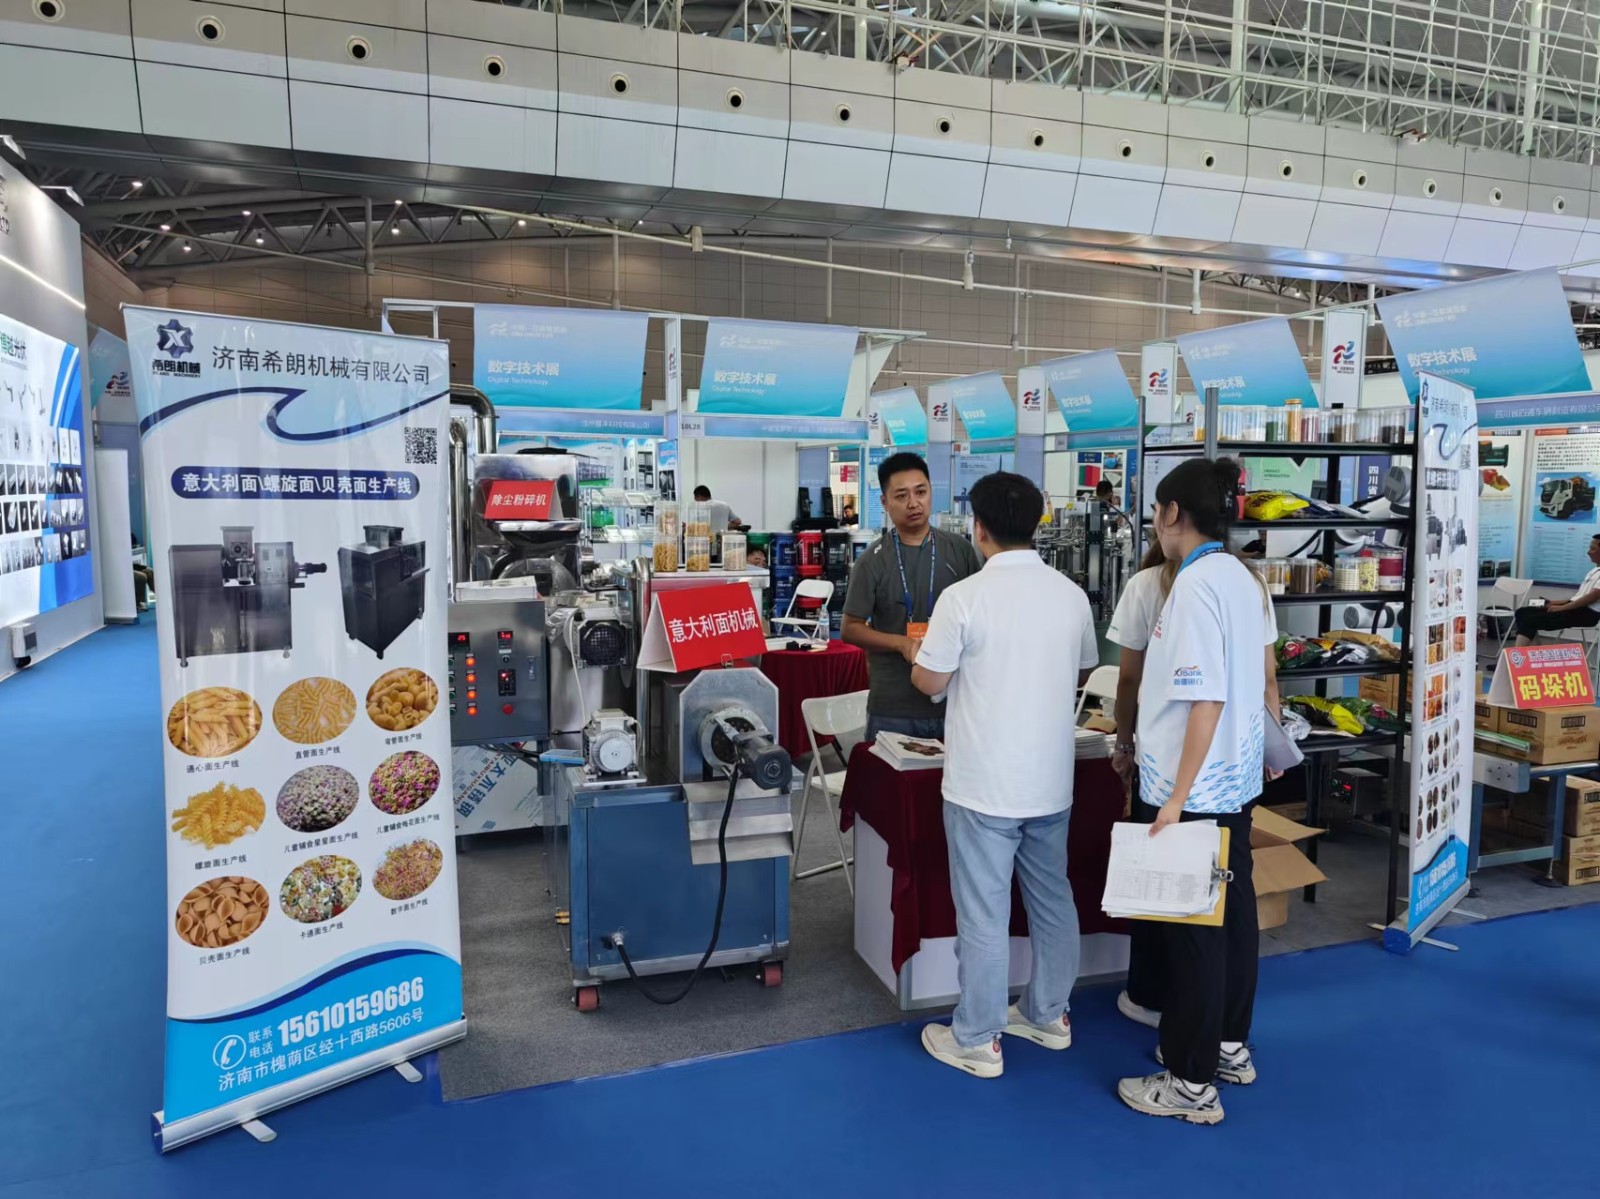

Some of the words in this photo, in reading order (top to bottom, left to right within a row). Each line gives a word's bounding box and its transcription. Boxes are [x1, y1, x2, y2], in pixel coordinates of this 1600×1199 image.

[212, 345, 431, 386] 济南希朗机械有限公司
[1407, 346, 1477, 368] 数字技术展
[488, 360, 560, 376] 数字技术展
[713, 370, 777, 386] 数字技术展
[182, 473, 412, 497] 意大利面\螺旋面\贝壳面生产线
[491, 494, 546, 506] 除尘粉碎机
[669, 607, 758, 643] 意大利面机械
[1518, 671, 1588, 701] 码垛机
[295, 746, 341, 760] 直管面生产线
[186, 759, 240, 774] 通心面生产线
[284, 831, 359, 854] 儿童辅食星星面生产线
[195, 854, 248, 870] 螺旋面生产线
[391, 897, 429, 916] 数字面生产线
[300, 921, 344, 941] 卡通面生产线
[199, 946, 251, 966] 贝壳面生产线
[278, 976, 424, 1047] 15610159686
[248, 1024, 273, 1044] 联系
[218, 1007, 424, 1092] 济南市槐荫区经十西路5606号
[249, 1040, 273, 1059] 电话
